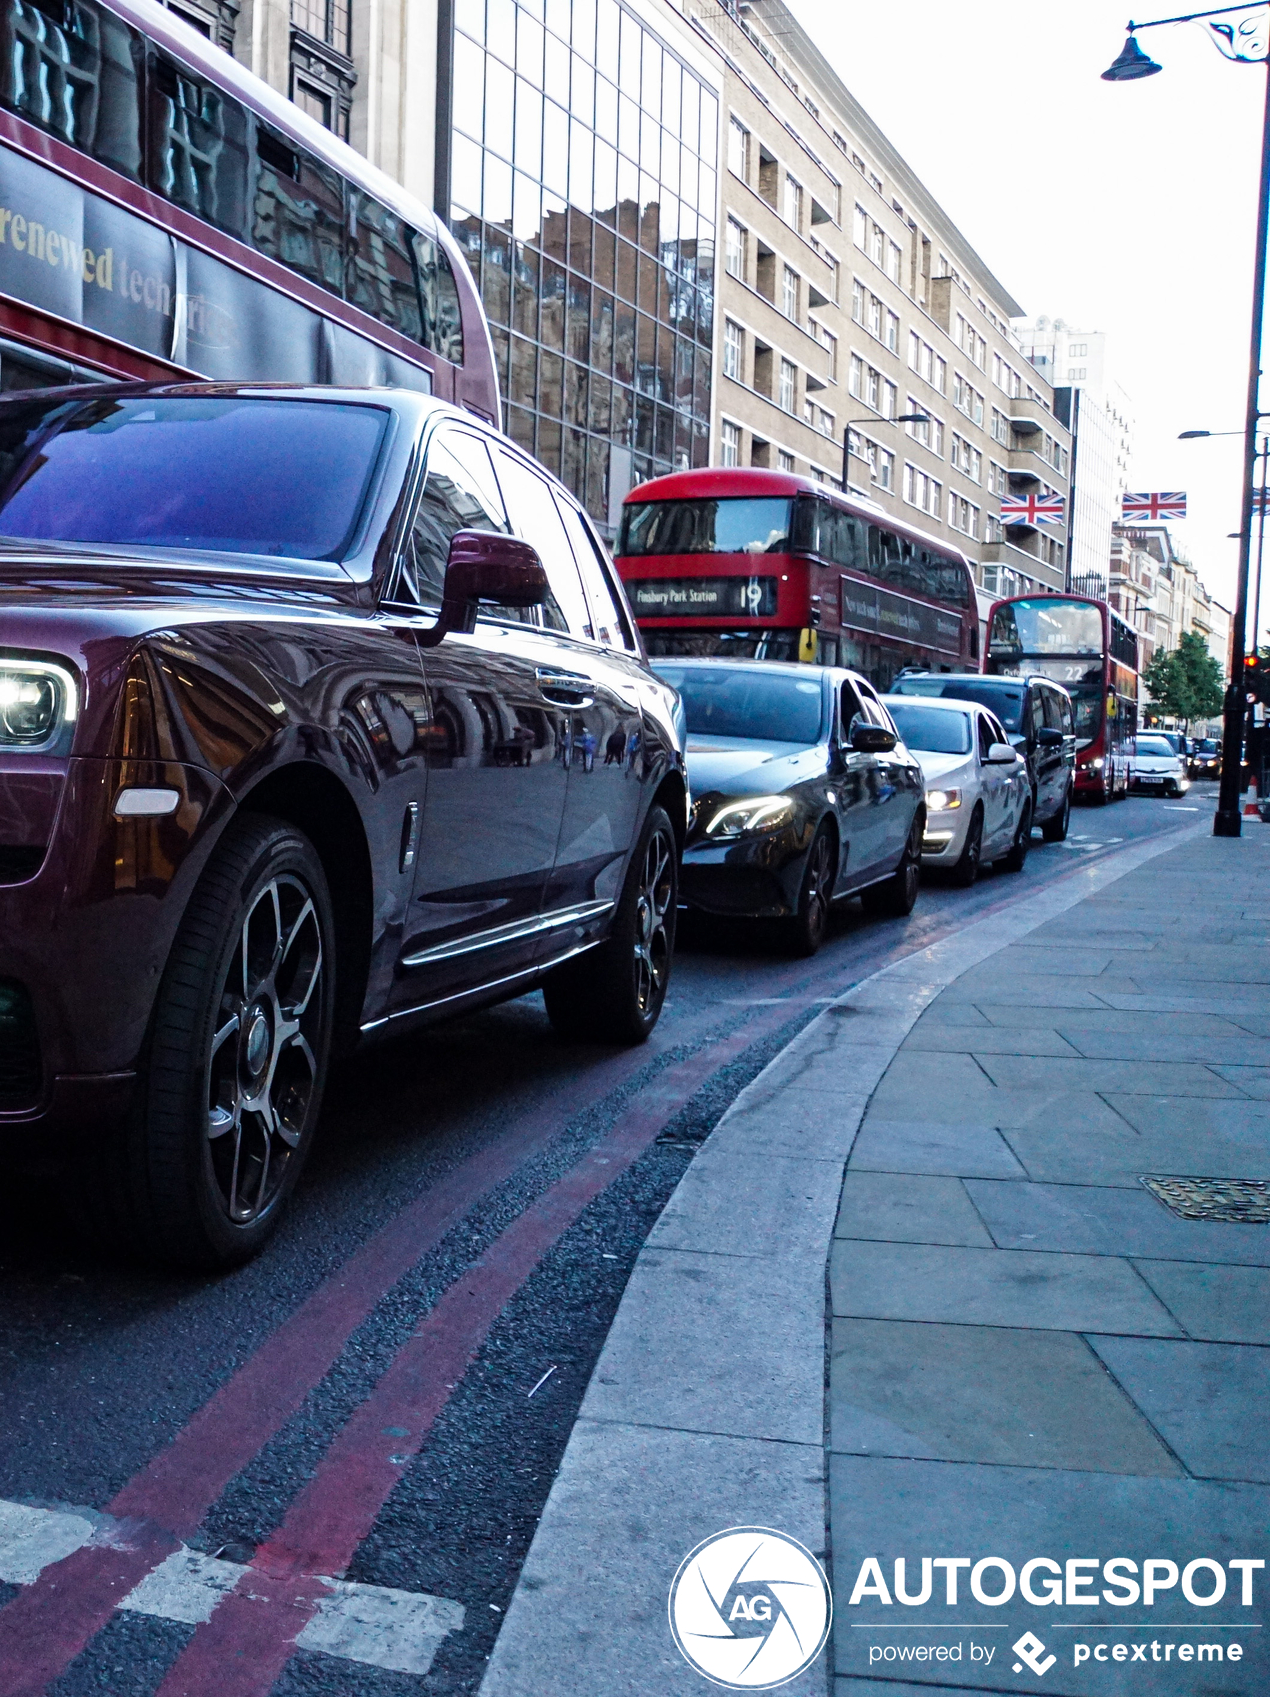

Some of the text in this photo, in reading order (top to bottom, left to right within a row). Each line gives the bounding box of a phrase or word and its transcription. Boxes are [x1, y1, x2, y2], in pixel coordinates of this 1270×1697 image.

[636, 584, 762, 609] Finsbury Park Station 19
[1065, 666, 1083, 681] 22
